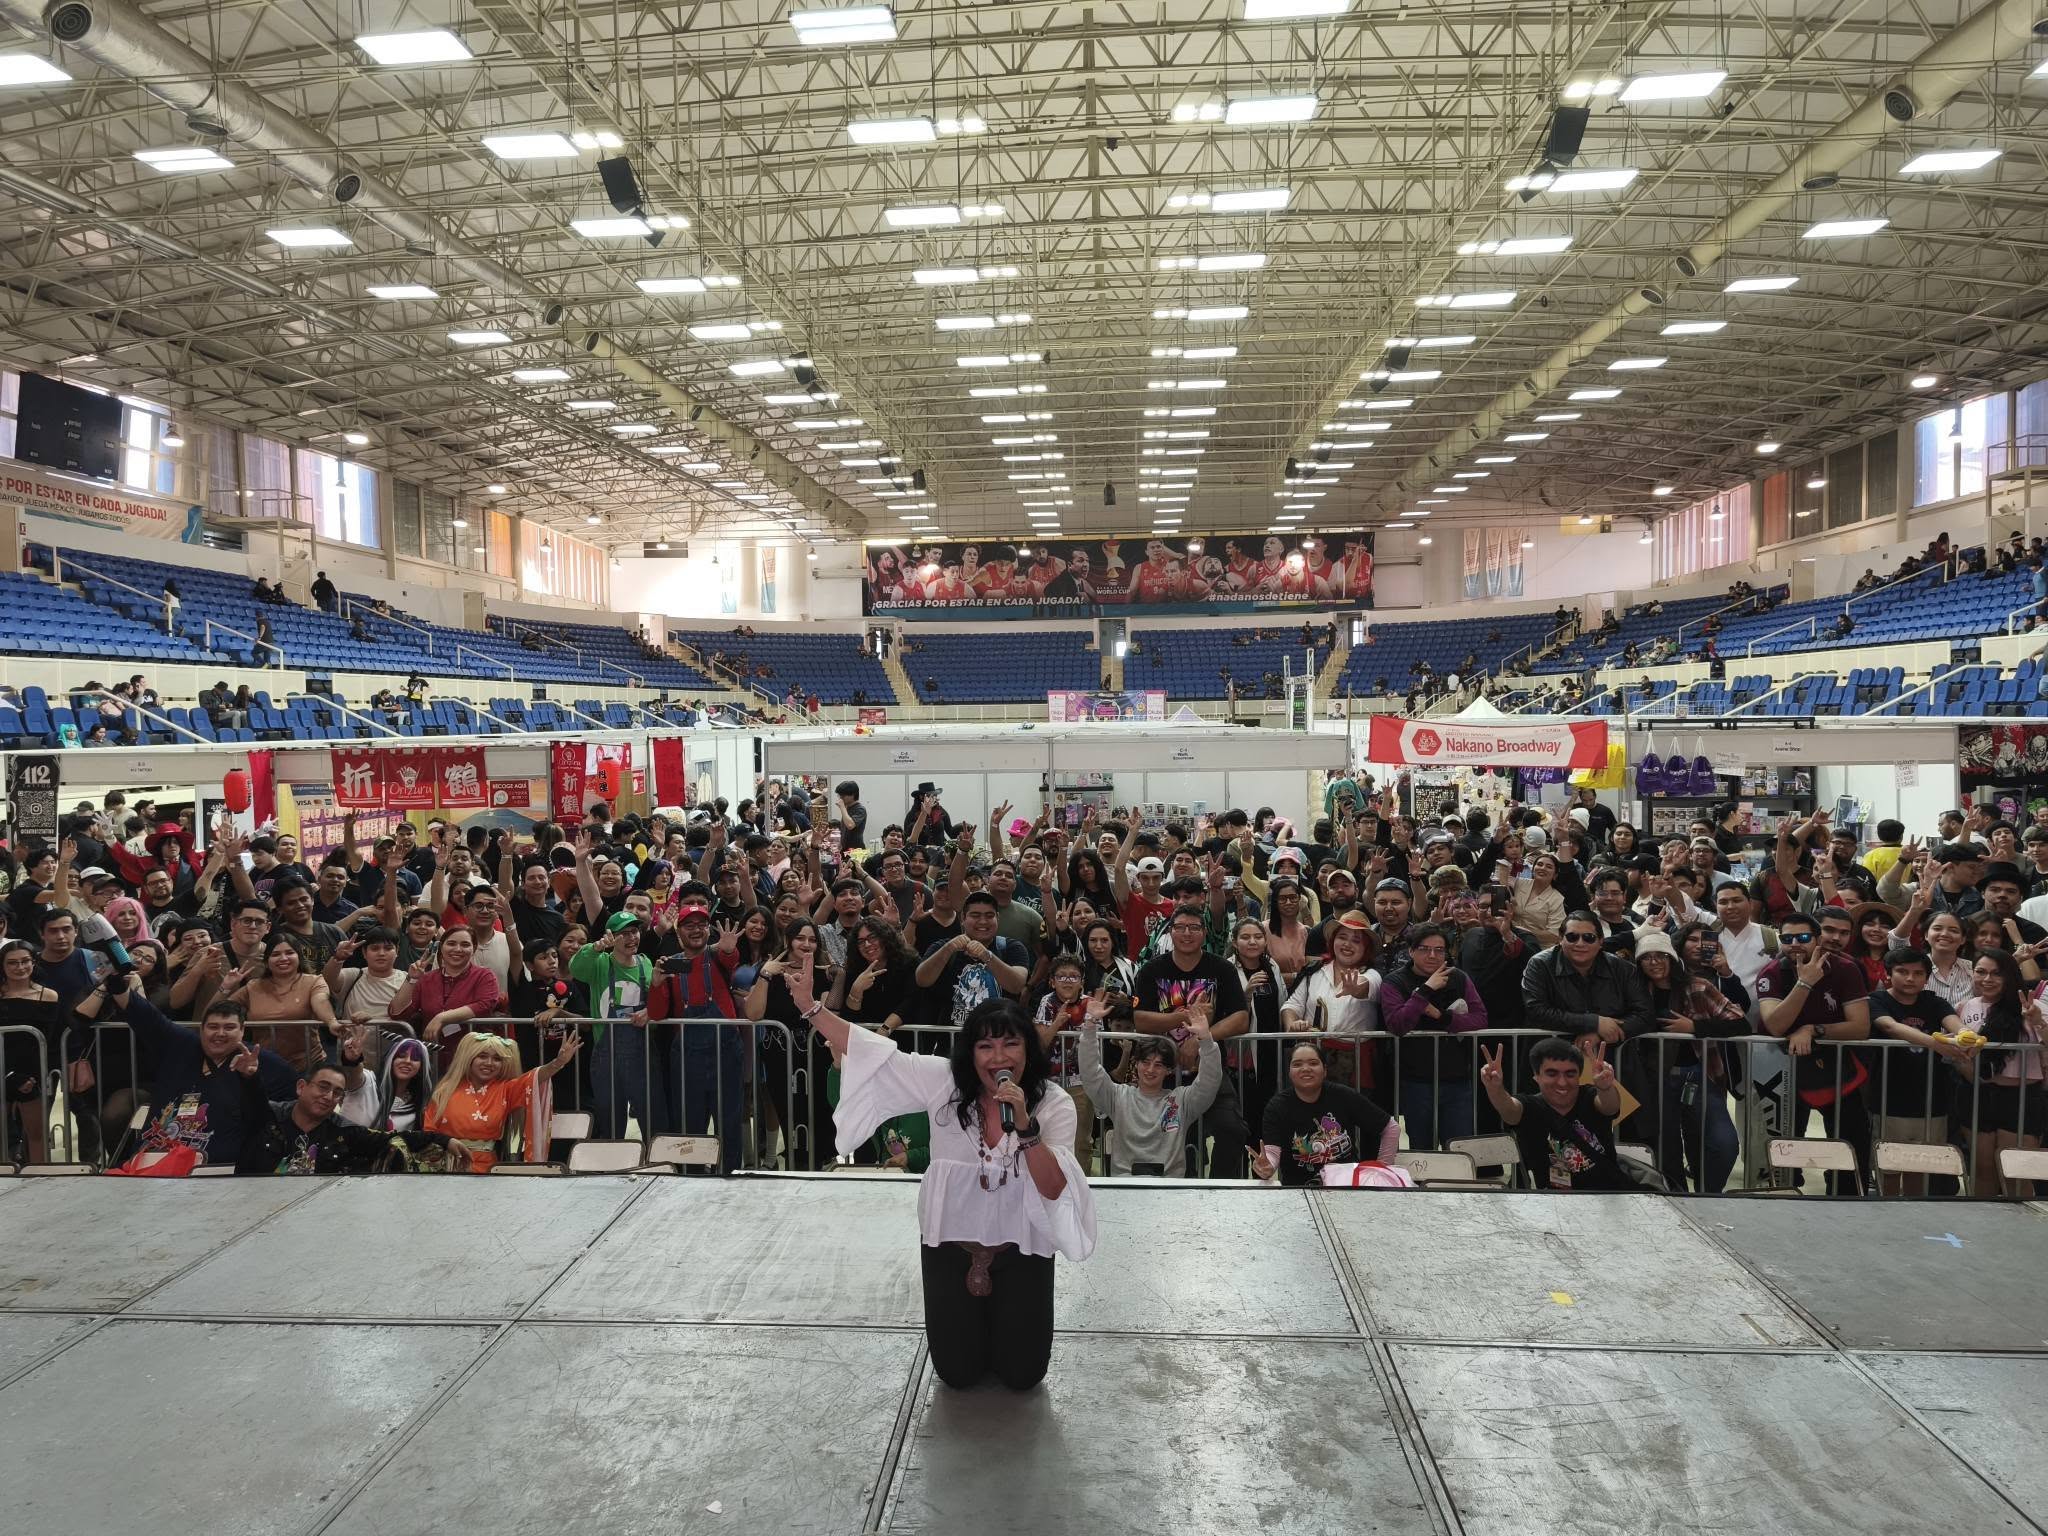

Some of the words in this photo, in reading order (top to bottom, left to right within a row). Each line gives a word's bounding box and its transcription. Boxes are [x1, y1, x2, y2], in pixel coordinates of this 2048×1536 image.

[6, 478, 33, 494] POR
[36, 484, 74, 503] ESTAR
[75, 493, 91, 506] EN
[93, 497, 123, 513] CADA
[123, 503, 168, 521] JUGADA!
[872, 600, 922, 610] ¡GRACIAS
[924, 600, 946, 608] POR
[949, 599, 984, 607] ESTAR
[1003, 598, 1034, 606] CADA
[1036, 597, 1085, 606] JUGADA!
[1208, 591, 1309, 602] #nadanosdetiene
[1446, 737, 1493, 753] Nakano
[1496, 738, 1562, 756] Broadway
[19, 765, 51, 785] 412
[341, 761, 376, 799] 折
[444, 761, 481, 798] 鶴
[389, 781, 433, 796] Orizuru
[561, 772, 580, 815] 折鶴
[1758, 977, 1770, 992] 3
